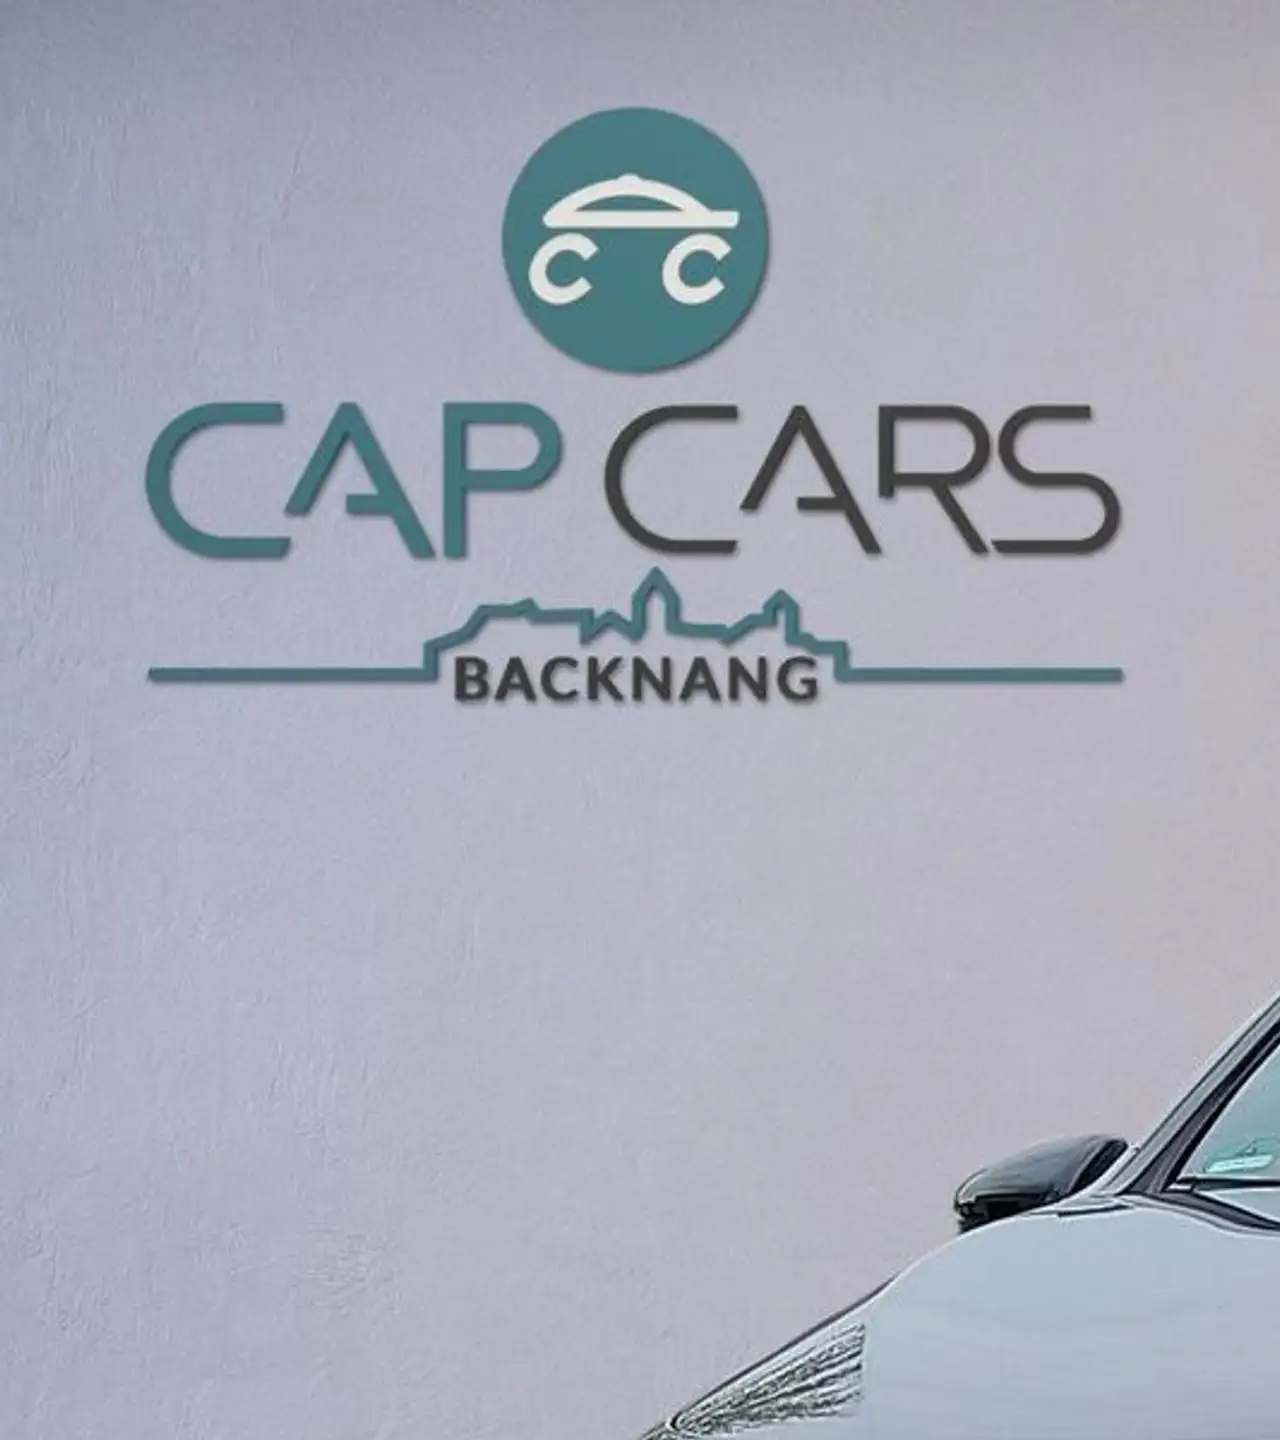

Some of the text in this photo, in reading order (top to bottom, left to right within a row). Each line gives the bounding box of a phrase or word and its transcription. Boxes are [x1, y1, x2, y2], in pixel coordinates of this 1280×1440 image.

[145, 402, 1121, 559] CAP CARS
[454, 656, 818, 702] BACKNANG
